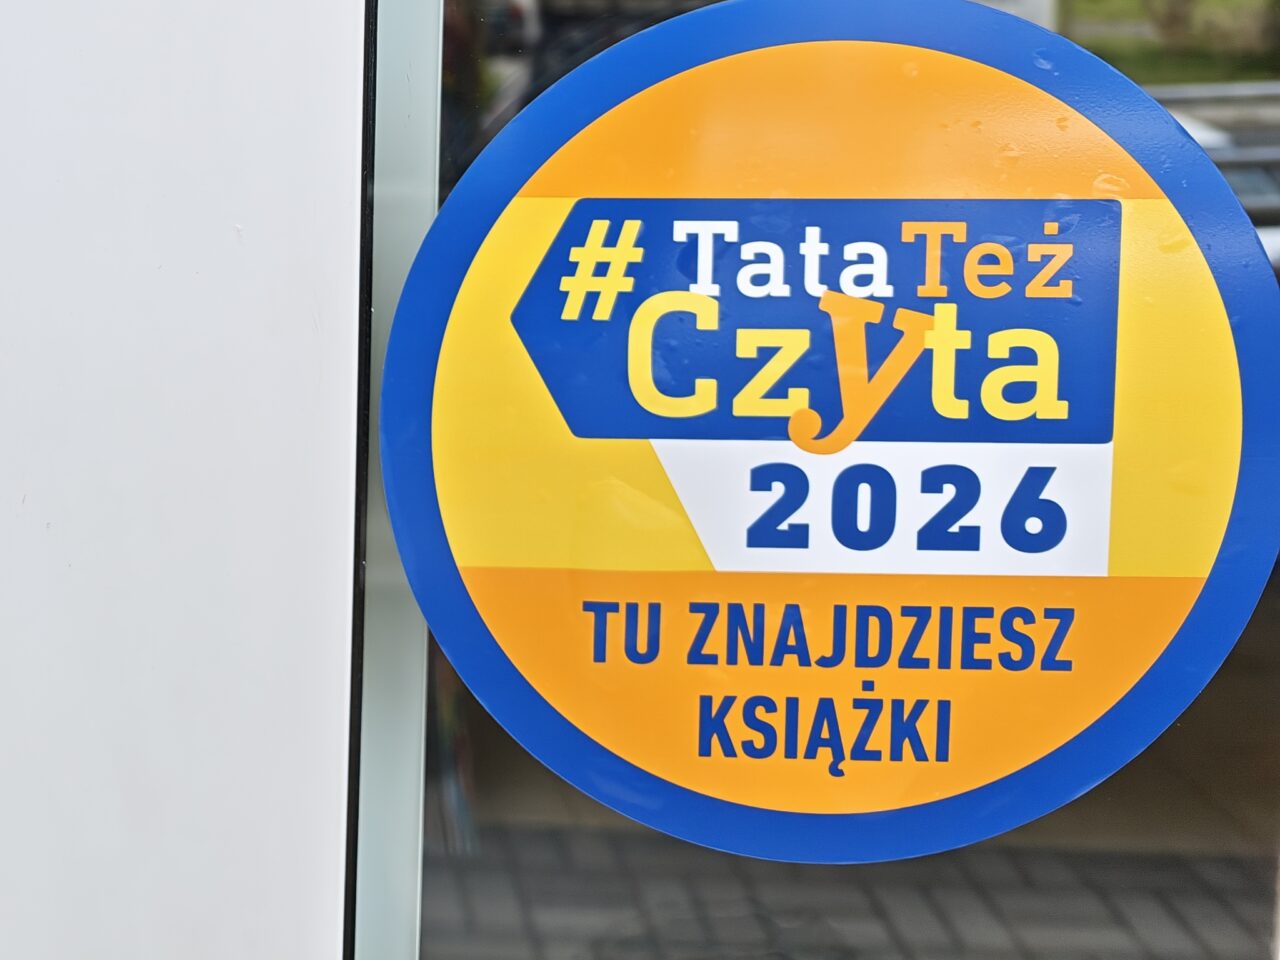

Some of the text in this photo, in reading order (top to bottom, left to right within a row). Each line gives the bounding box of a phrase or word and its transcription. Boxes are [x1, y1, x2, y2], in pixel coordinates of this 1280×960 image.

[627, 290, 1069, 455] Czyta
[745, 462, 1068, 554] 2026
[582, 601, 1076, 672] TU ZNAJDZIESZ
[696, 680, 952, 778] KSIĄŻKI
